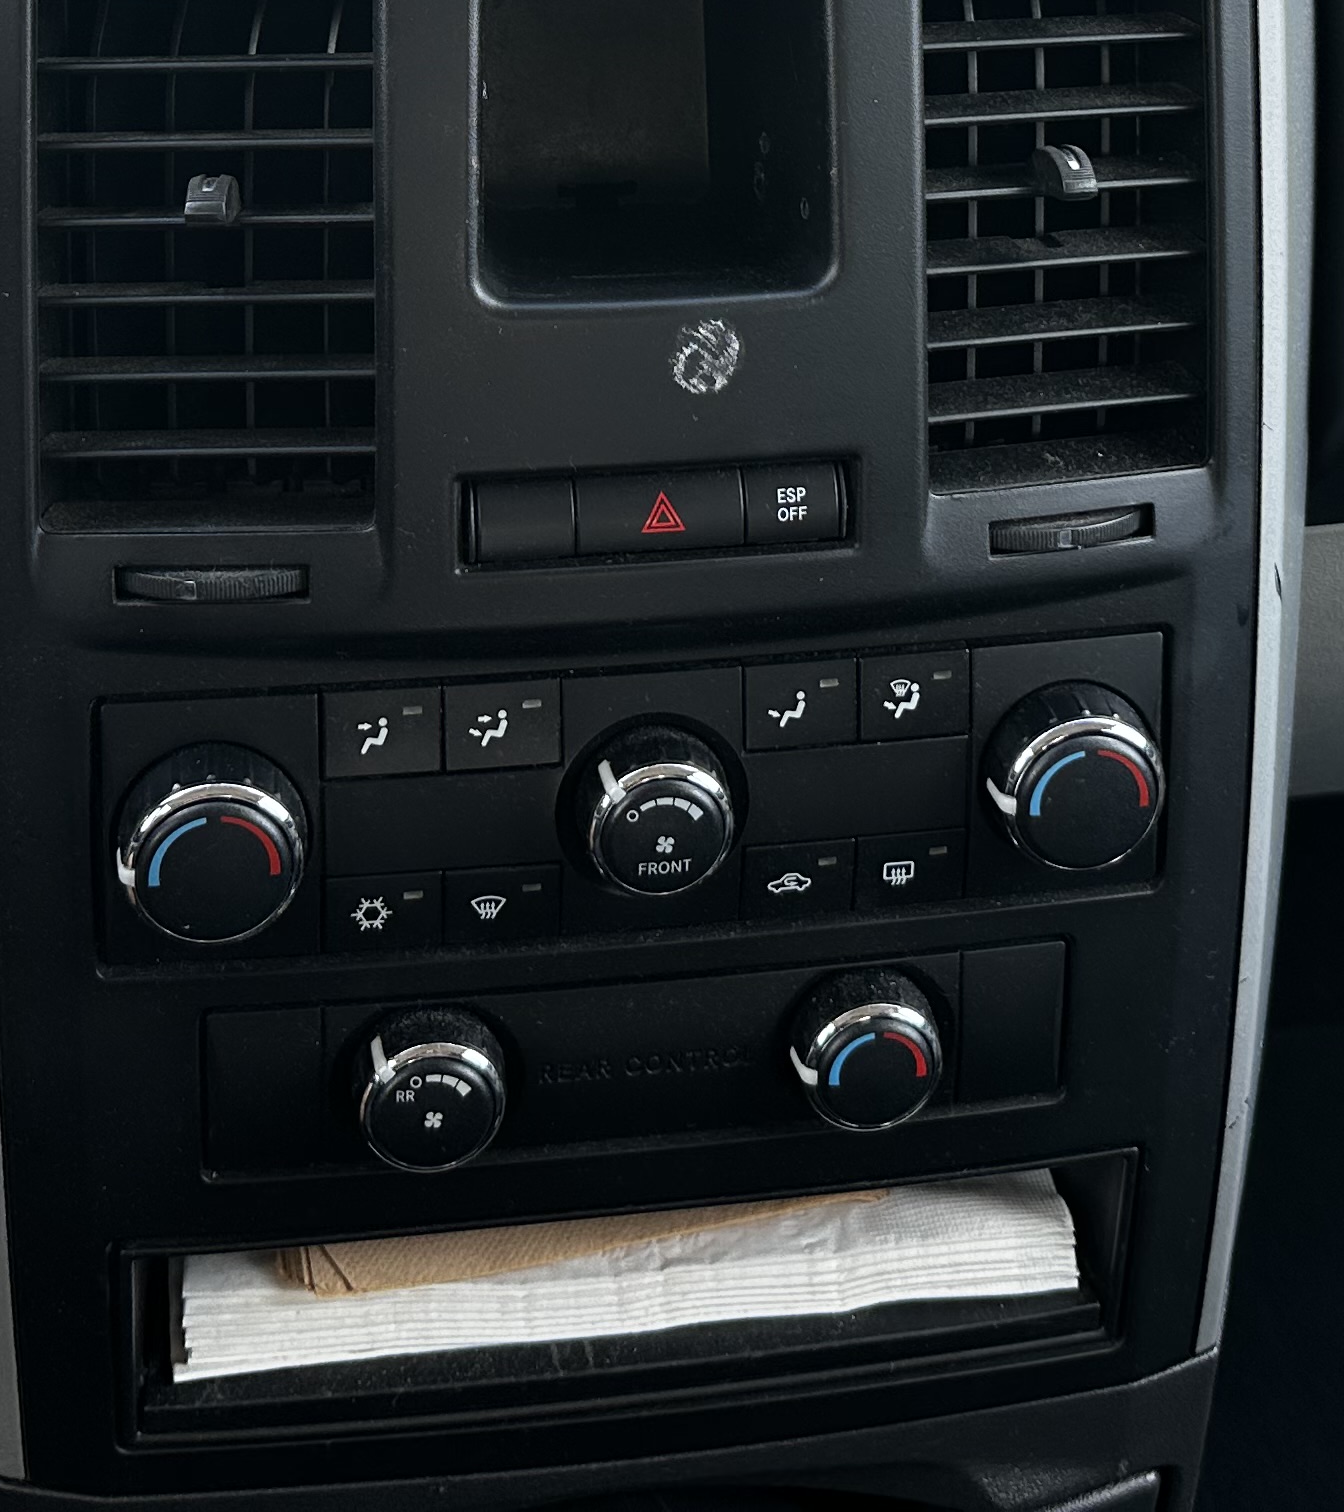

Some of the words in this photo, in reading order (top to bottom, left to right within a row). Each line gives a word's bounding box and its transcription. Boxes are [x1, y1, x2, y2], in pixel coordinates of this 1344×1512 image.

[777, 486, 807, 504] ESP
[777, 505, 808, 522] OFF
[638, 857, 693, 876] FRONT
[396, 1089, 416, 1103] RR
